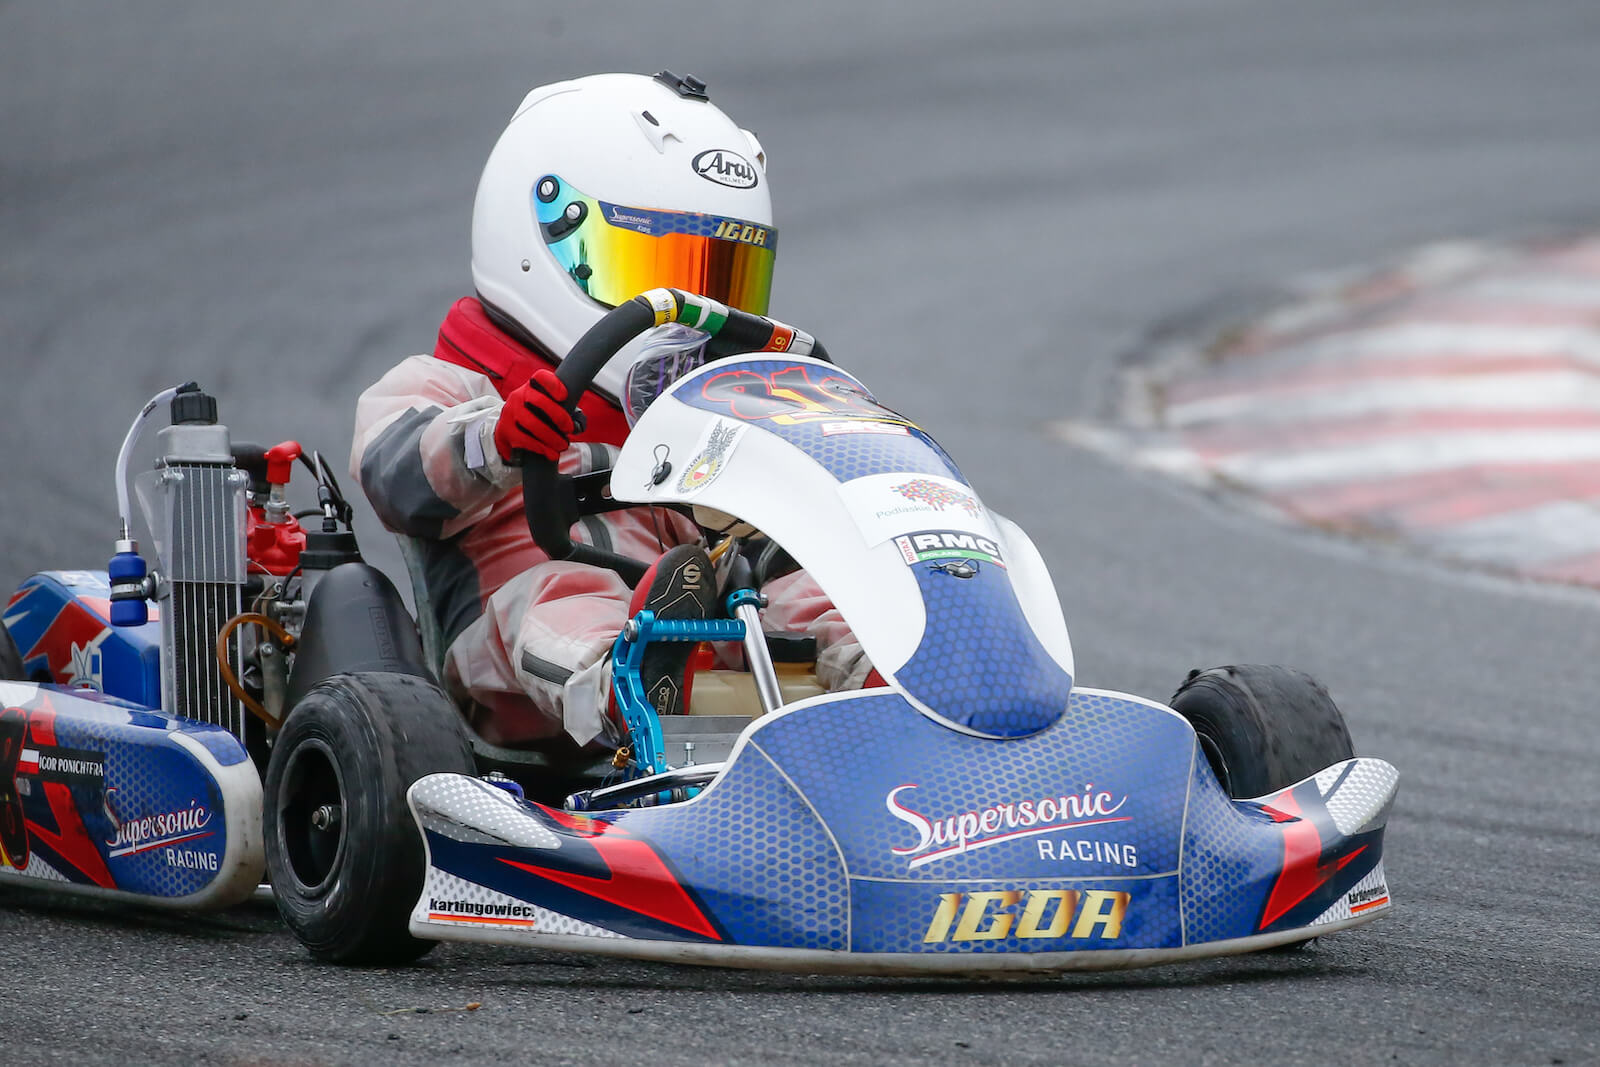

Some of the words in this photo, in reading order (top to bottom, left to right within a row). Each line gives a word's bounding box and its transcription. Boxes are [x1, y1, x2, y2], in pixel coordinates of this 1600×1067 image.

[699, 152, 753, 181] Arai
[38, 755, 57, 771] IGOR
[104, 787, 212, 854] Supersonic
[886, 783, 1128, 856] Supersonic
[166, 847, 218, 871] RACING
[1037, 839, 1138, 868] RACING
